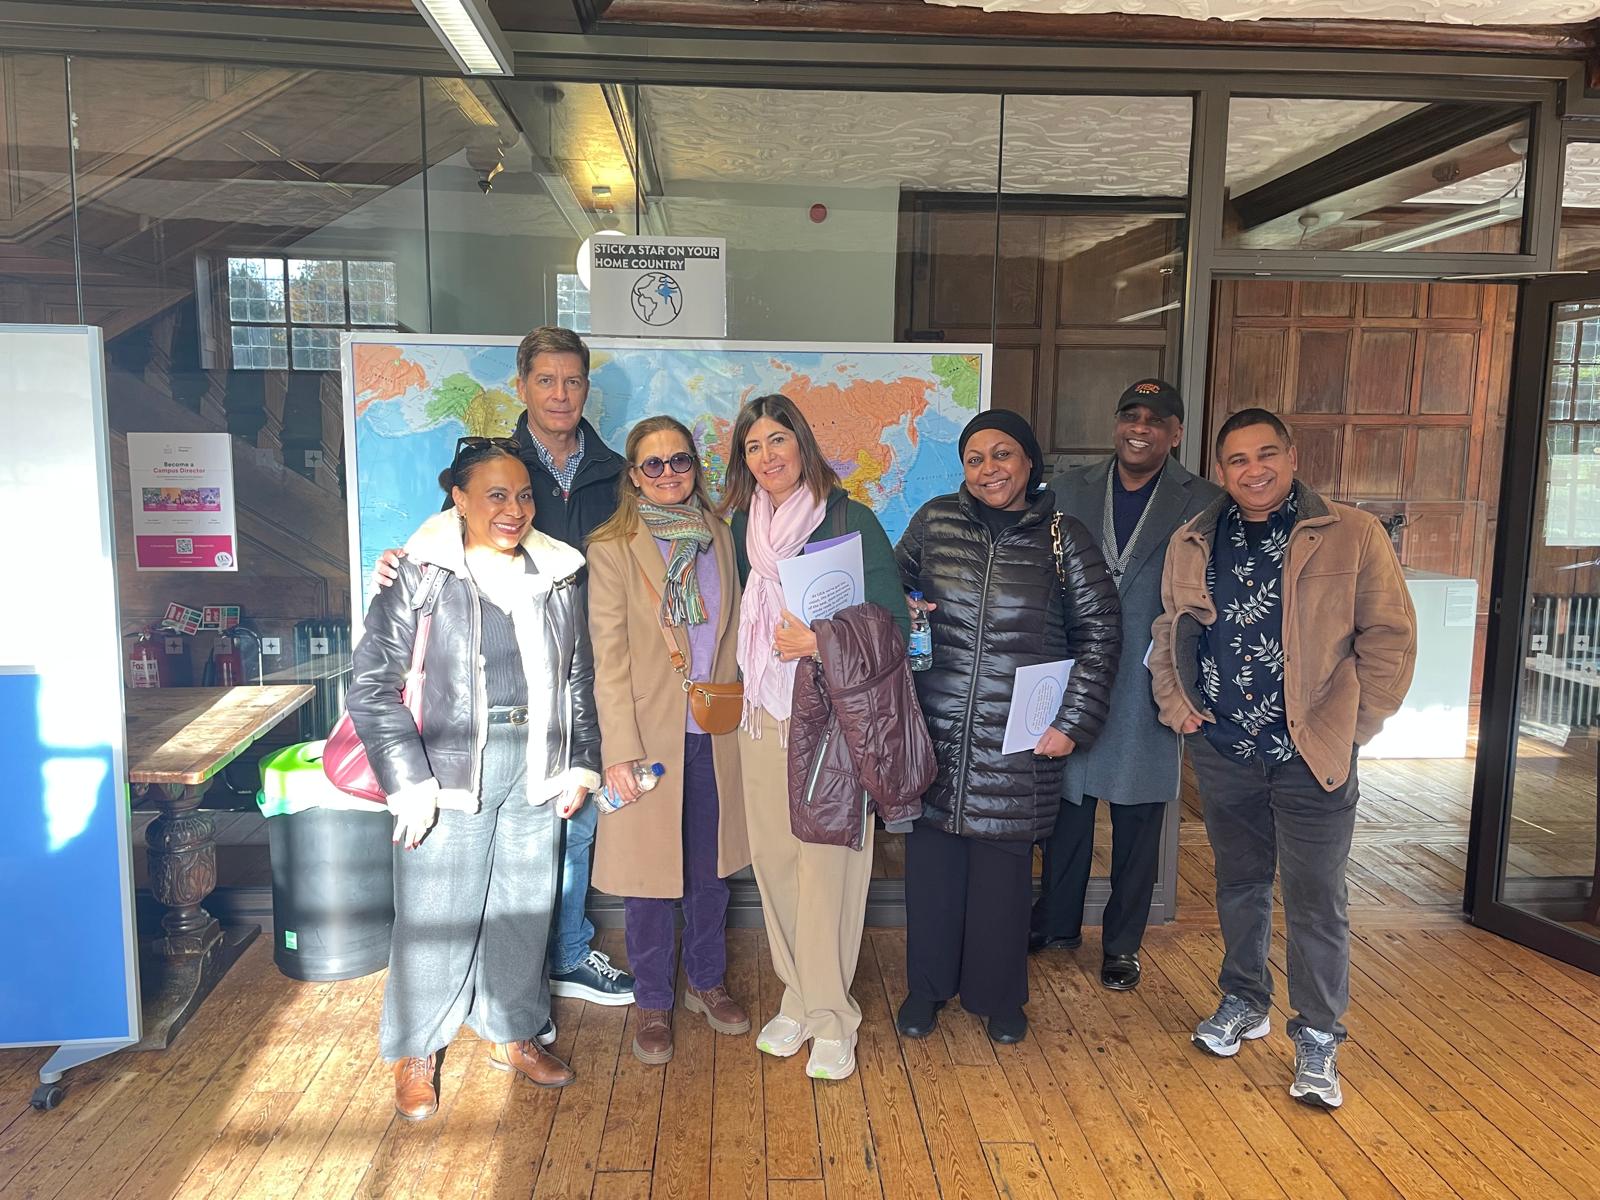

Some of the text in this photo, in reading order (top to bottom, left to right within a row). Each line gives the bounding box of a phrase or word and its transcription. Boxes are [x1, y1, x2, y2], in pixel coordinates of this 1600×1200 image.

[594, 244, 718, 257] STICK A STAR ON YOUR
[595, 258, 684, 270] HOME COUNTRY
